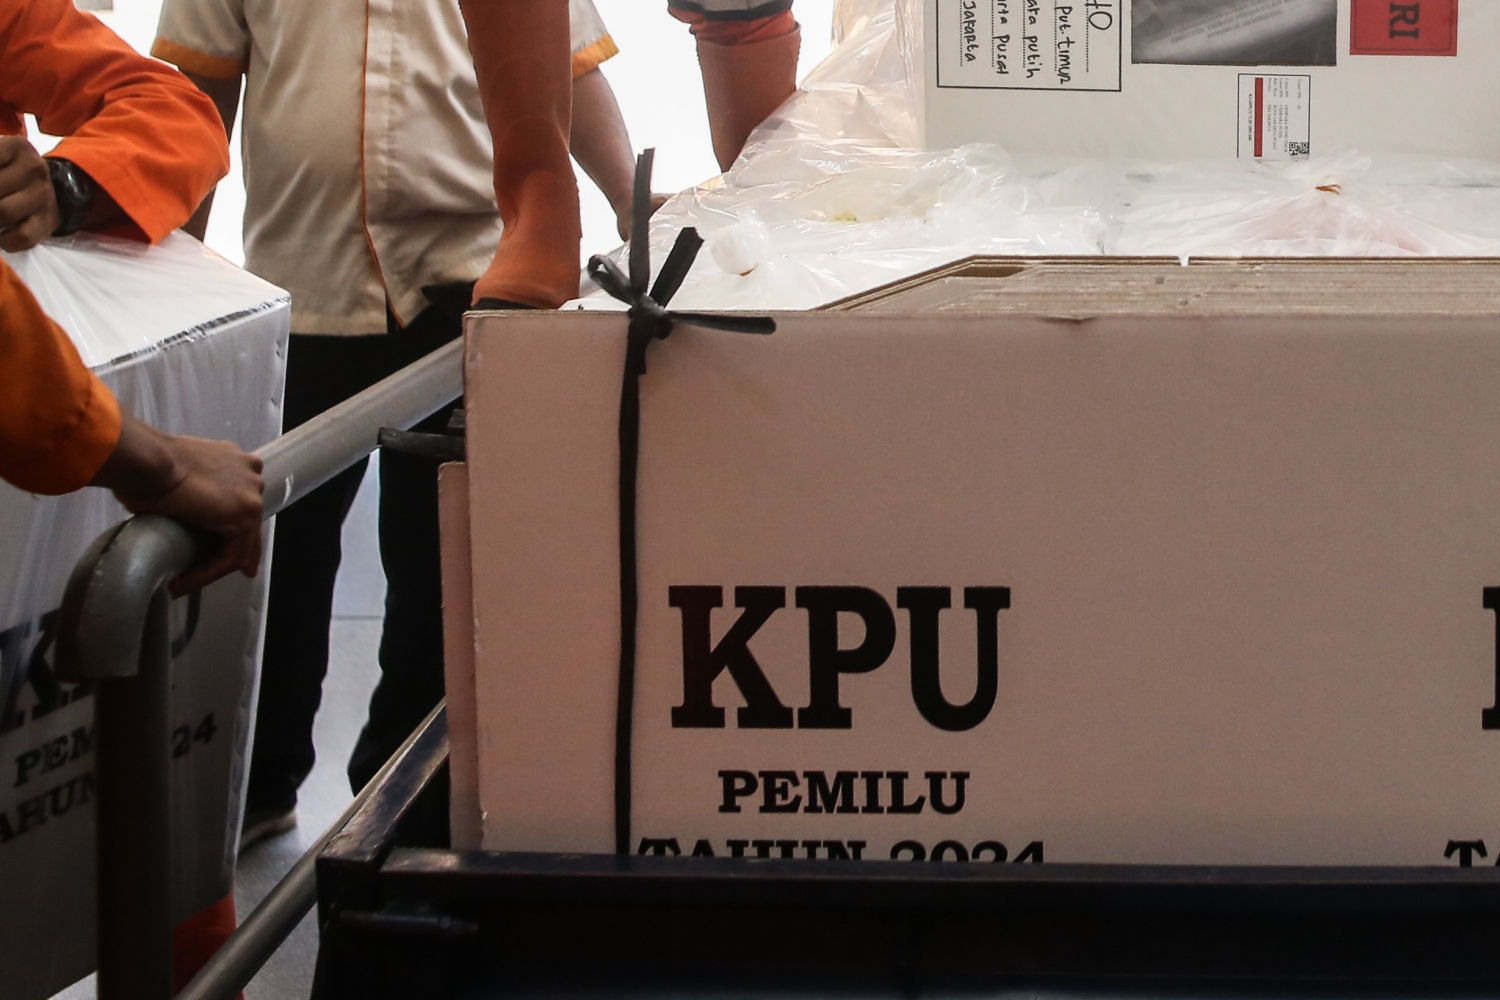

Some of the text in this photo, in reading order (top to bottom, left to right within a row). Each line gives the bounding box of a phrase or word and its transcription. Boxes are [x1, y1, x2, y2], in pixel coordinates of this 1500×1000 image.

[1389, 4, 1419, 39] RI
[668, 585, 1011, 731] KPU
[718, 770, 970, 814] PEMILU
